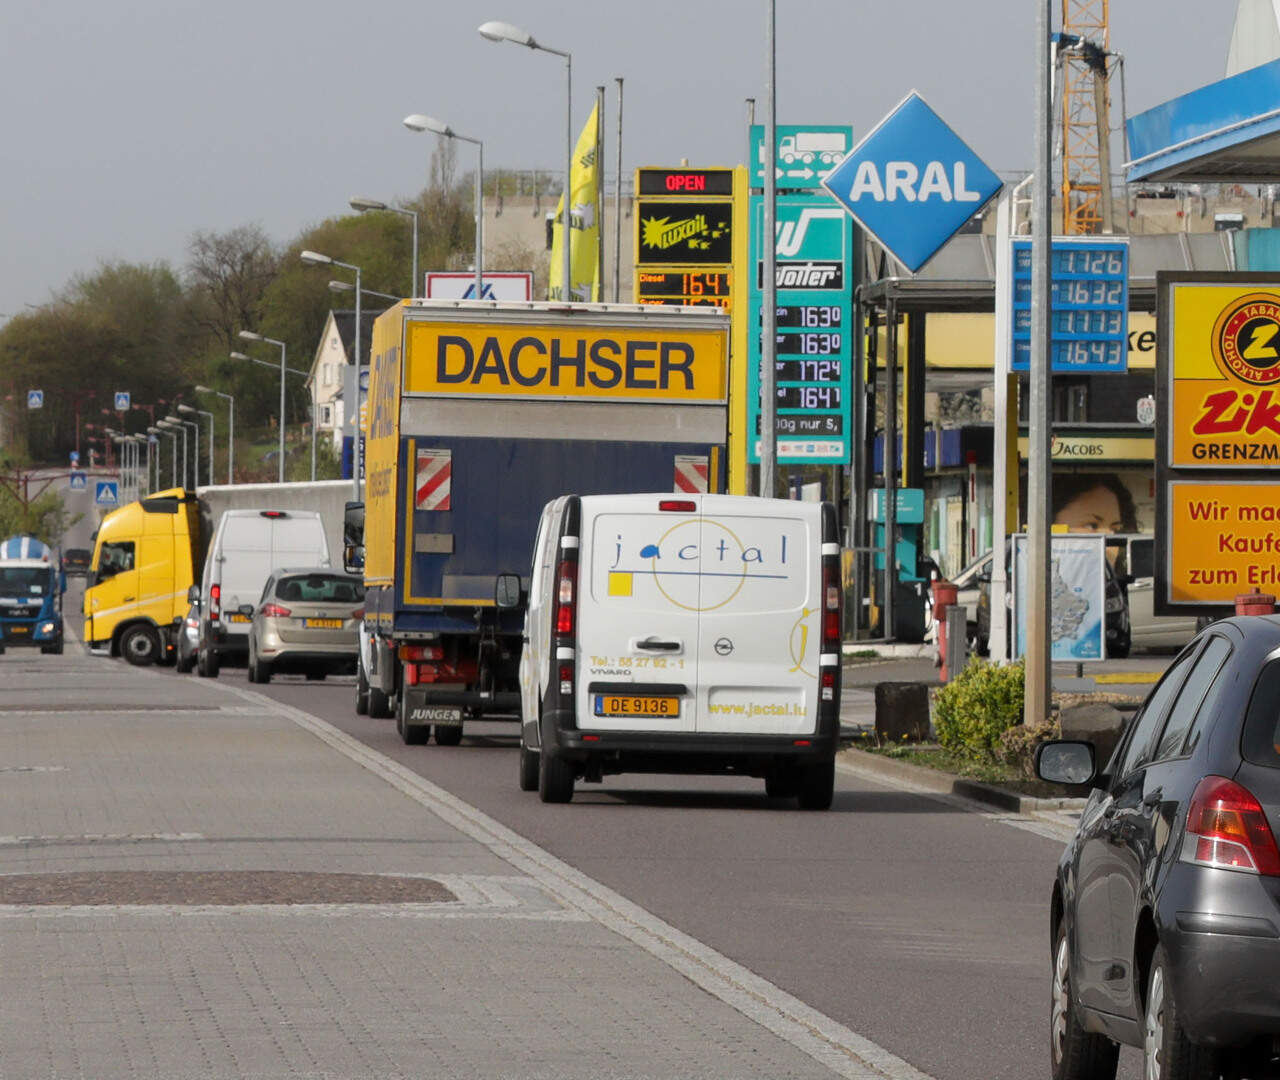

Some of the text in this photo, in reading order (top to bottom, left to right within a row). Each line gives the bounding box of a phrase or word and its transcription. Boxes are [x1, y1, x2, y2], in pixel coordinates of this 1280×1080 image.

[665, 175, 706, 191] OPEN
[849, 161, 980, 202] ARAL
[435, 335, 695, 391] DACHSER
[1224, 333, 1262, 381] ALKOHOL
[1052, 441, 1104, 457] JACOBS
[1188, 501, 1230, 521] Wir
[611, 534, 787, 569] jactal
[1189, 569, 1238, 585] zum
[590, 668, 632, 676] VIVARO
[610, 699, 669, 713] DE 9136
